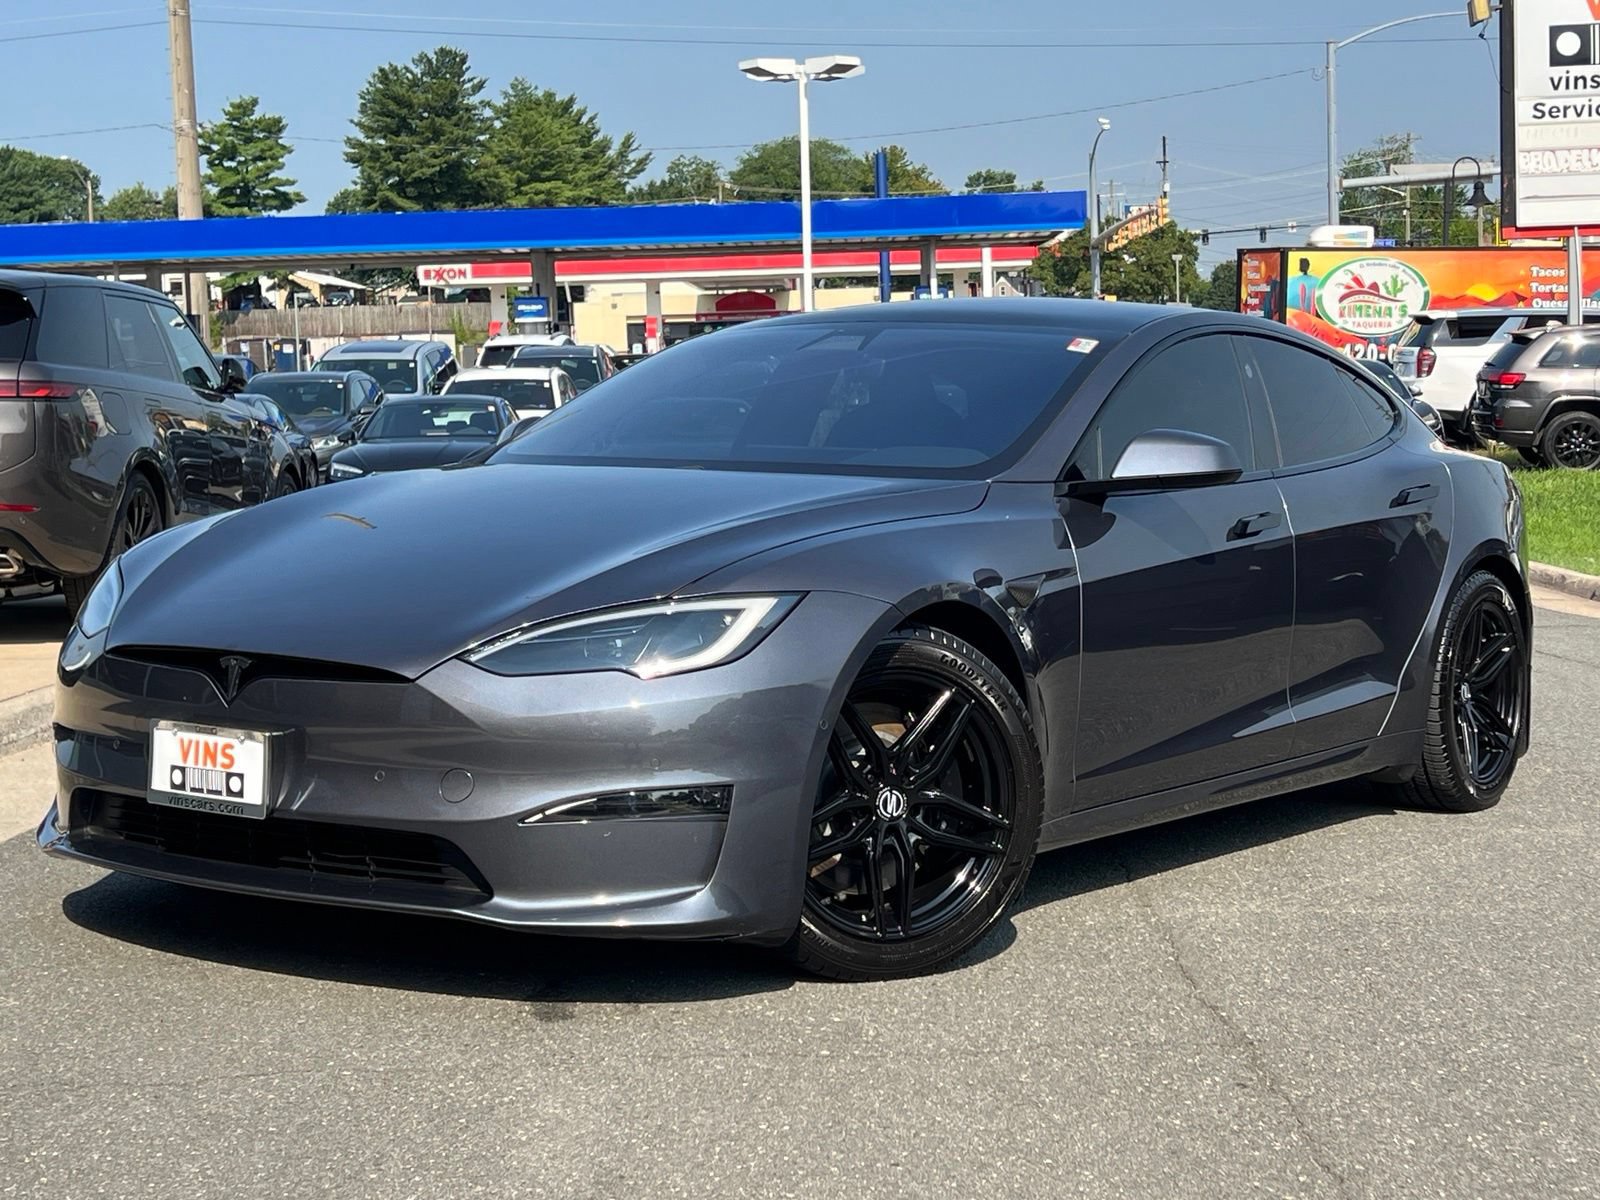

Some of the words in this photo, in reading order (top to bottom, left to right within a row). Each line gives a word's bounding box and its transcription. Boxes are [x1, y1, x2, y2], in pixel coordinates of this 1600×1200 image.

[424, 267, 467, 282] EXXON
[1529, 266, 1566, 277] Tacos
[1338, 303, 1409, 319] XIMENA'S
[1351, 320, 1393, 329] TAQUERIA
[940, 654, 1008, 712] GOODYEAR
[178, 737, 235, 770] VINS
[167, 795, 244, 816] vinscars.com
